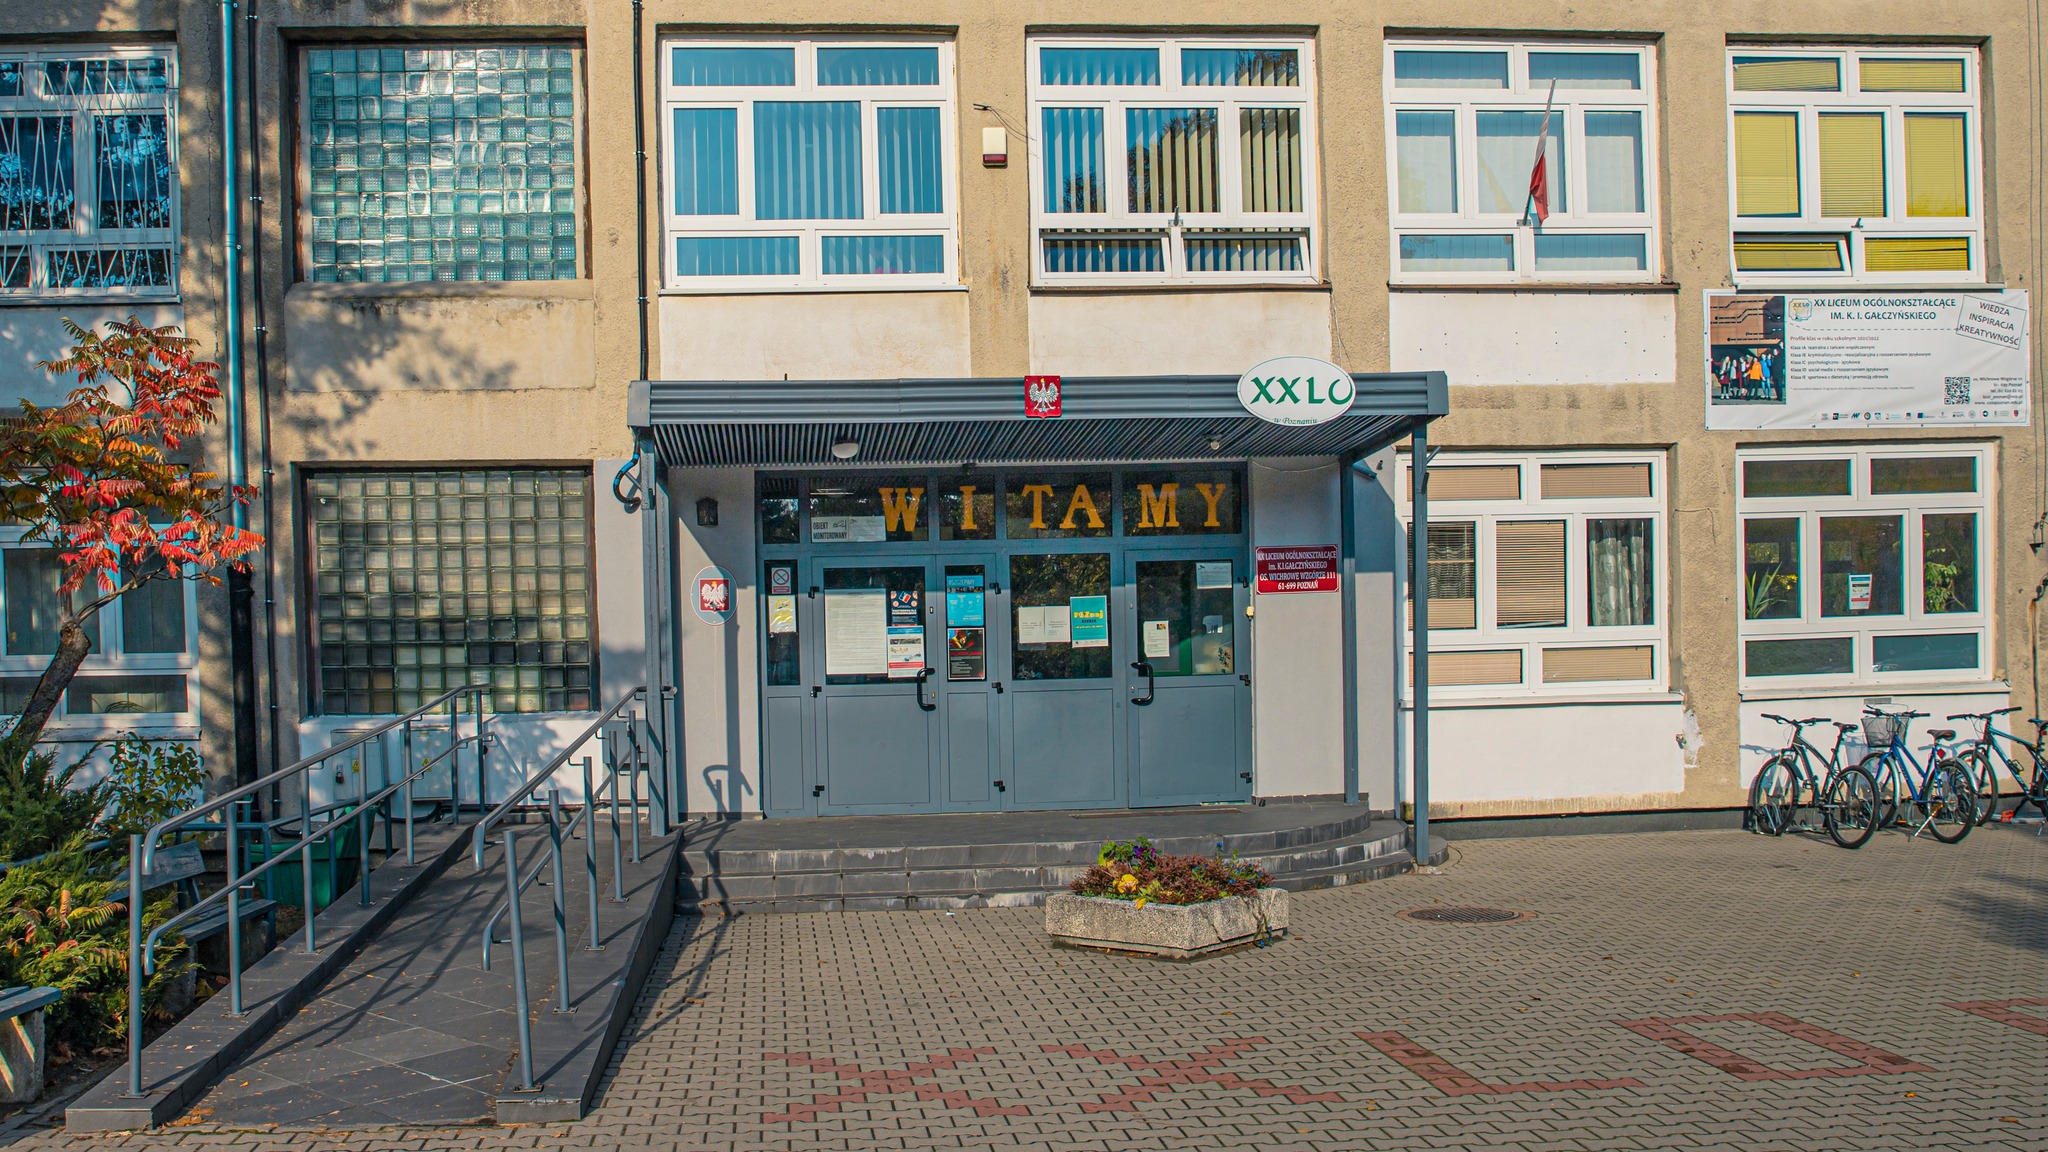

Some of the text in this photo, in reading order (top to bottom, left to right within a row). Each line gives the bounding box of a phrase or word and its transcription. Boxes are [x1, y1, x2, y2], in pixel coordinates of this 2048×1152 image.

[1864, 297, 1956, 309] OGÓLNOKSZTAŁCĄCE
[1979, 302, 2010, 316] WIEDZA
[1865, 310, 1936, 320] GAŁCZYŃSKIEGO
[1969, 313, 2014, 331] INSPIRACJA
[1959, 324, 2020, 345] KREATYWNOŚĆ
[1283, 417, 1318, 425] Poznaniu
[1285, 550, 1336, 560] OGÓLNOKSZTAŁCĄCE
[1300, 570, 1326, 580] WZGÓRZE
[1297, 580, 1318, 589] POZNAŃ
